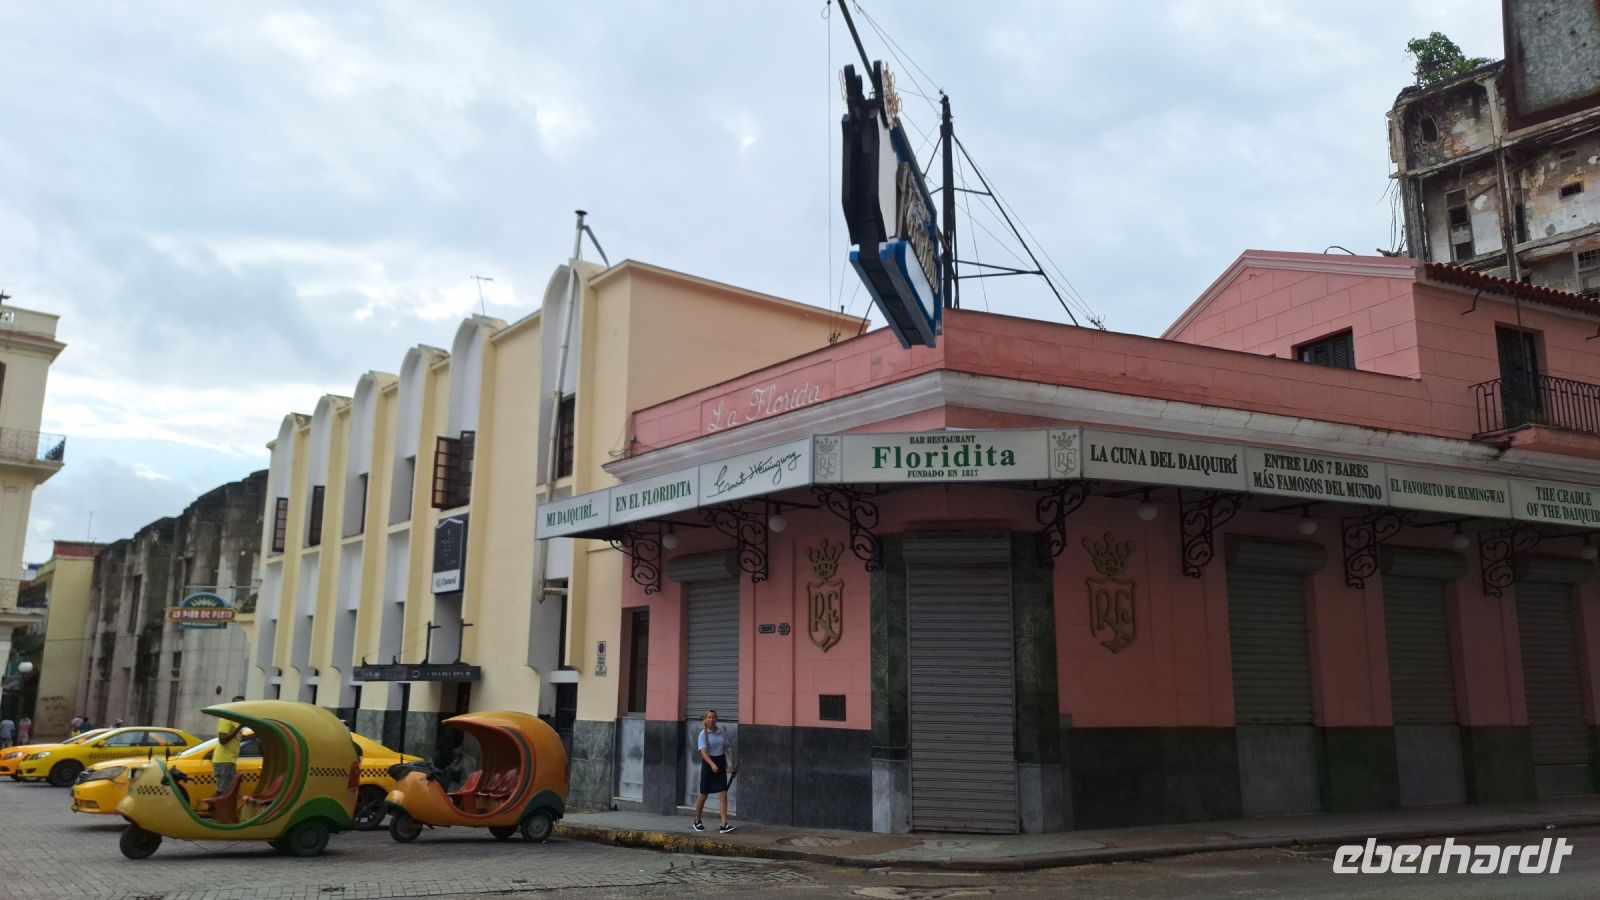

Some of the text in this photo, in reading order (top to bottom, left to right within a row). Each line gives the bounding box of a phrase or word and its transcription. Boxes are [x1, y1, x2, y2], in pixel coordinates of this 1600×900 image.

[707, 381, 822, 432] La Florida
[909, 435, 976, 444] BAR RESTAURANT
[872, 443, 1016, 469] Floridita
[1090, 444, 1238, 476] LA CUNA DEL DAIQUIRÍ
[1264, 453, 1369, 478] ENTRE LOS 7 BARES
[907, 469, 979, 478] FUNDADO EN 1817
[1253, 469, 1382, 500] MÁS FAMOSOS DEL MUNDO
[615, 480, 692, 512] EN EL FLORIDITA
[1390, 478, 1505, 504] EL FAVORITO DE HEMINGWAY
[1535, 486, 1592, 506] THE CRADLE
[546, 511, 556, 527] MI
[1526, 502, 1541, 517] OF
[1541, 503, 1562, 519] THE
